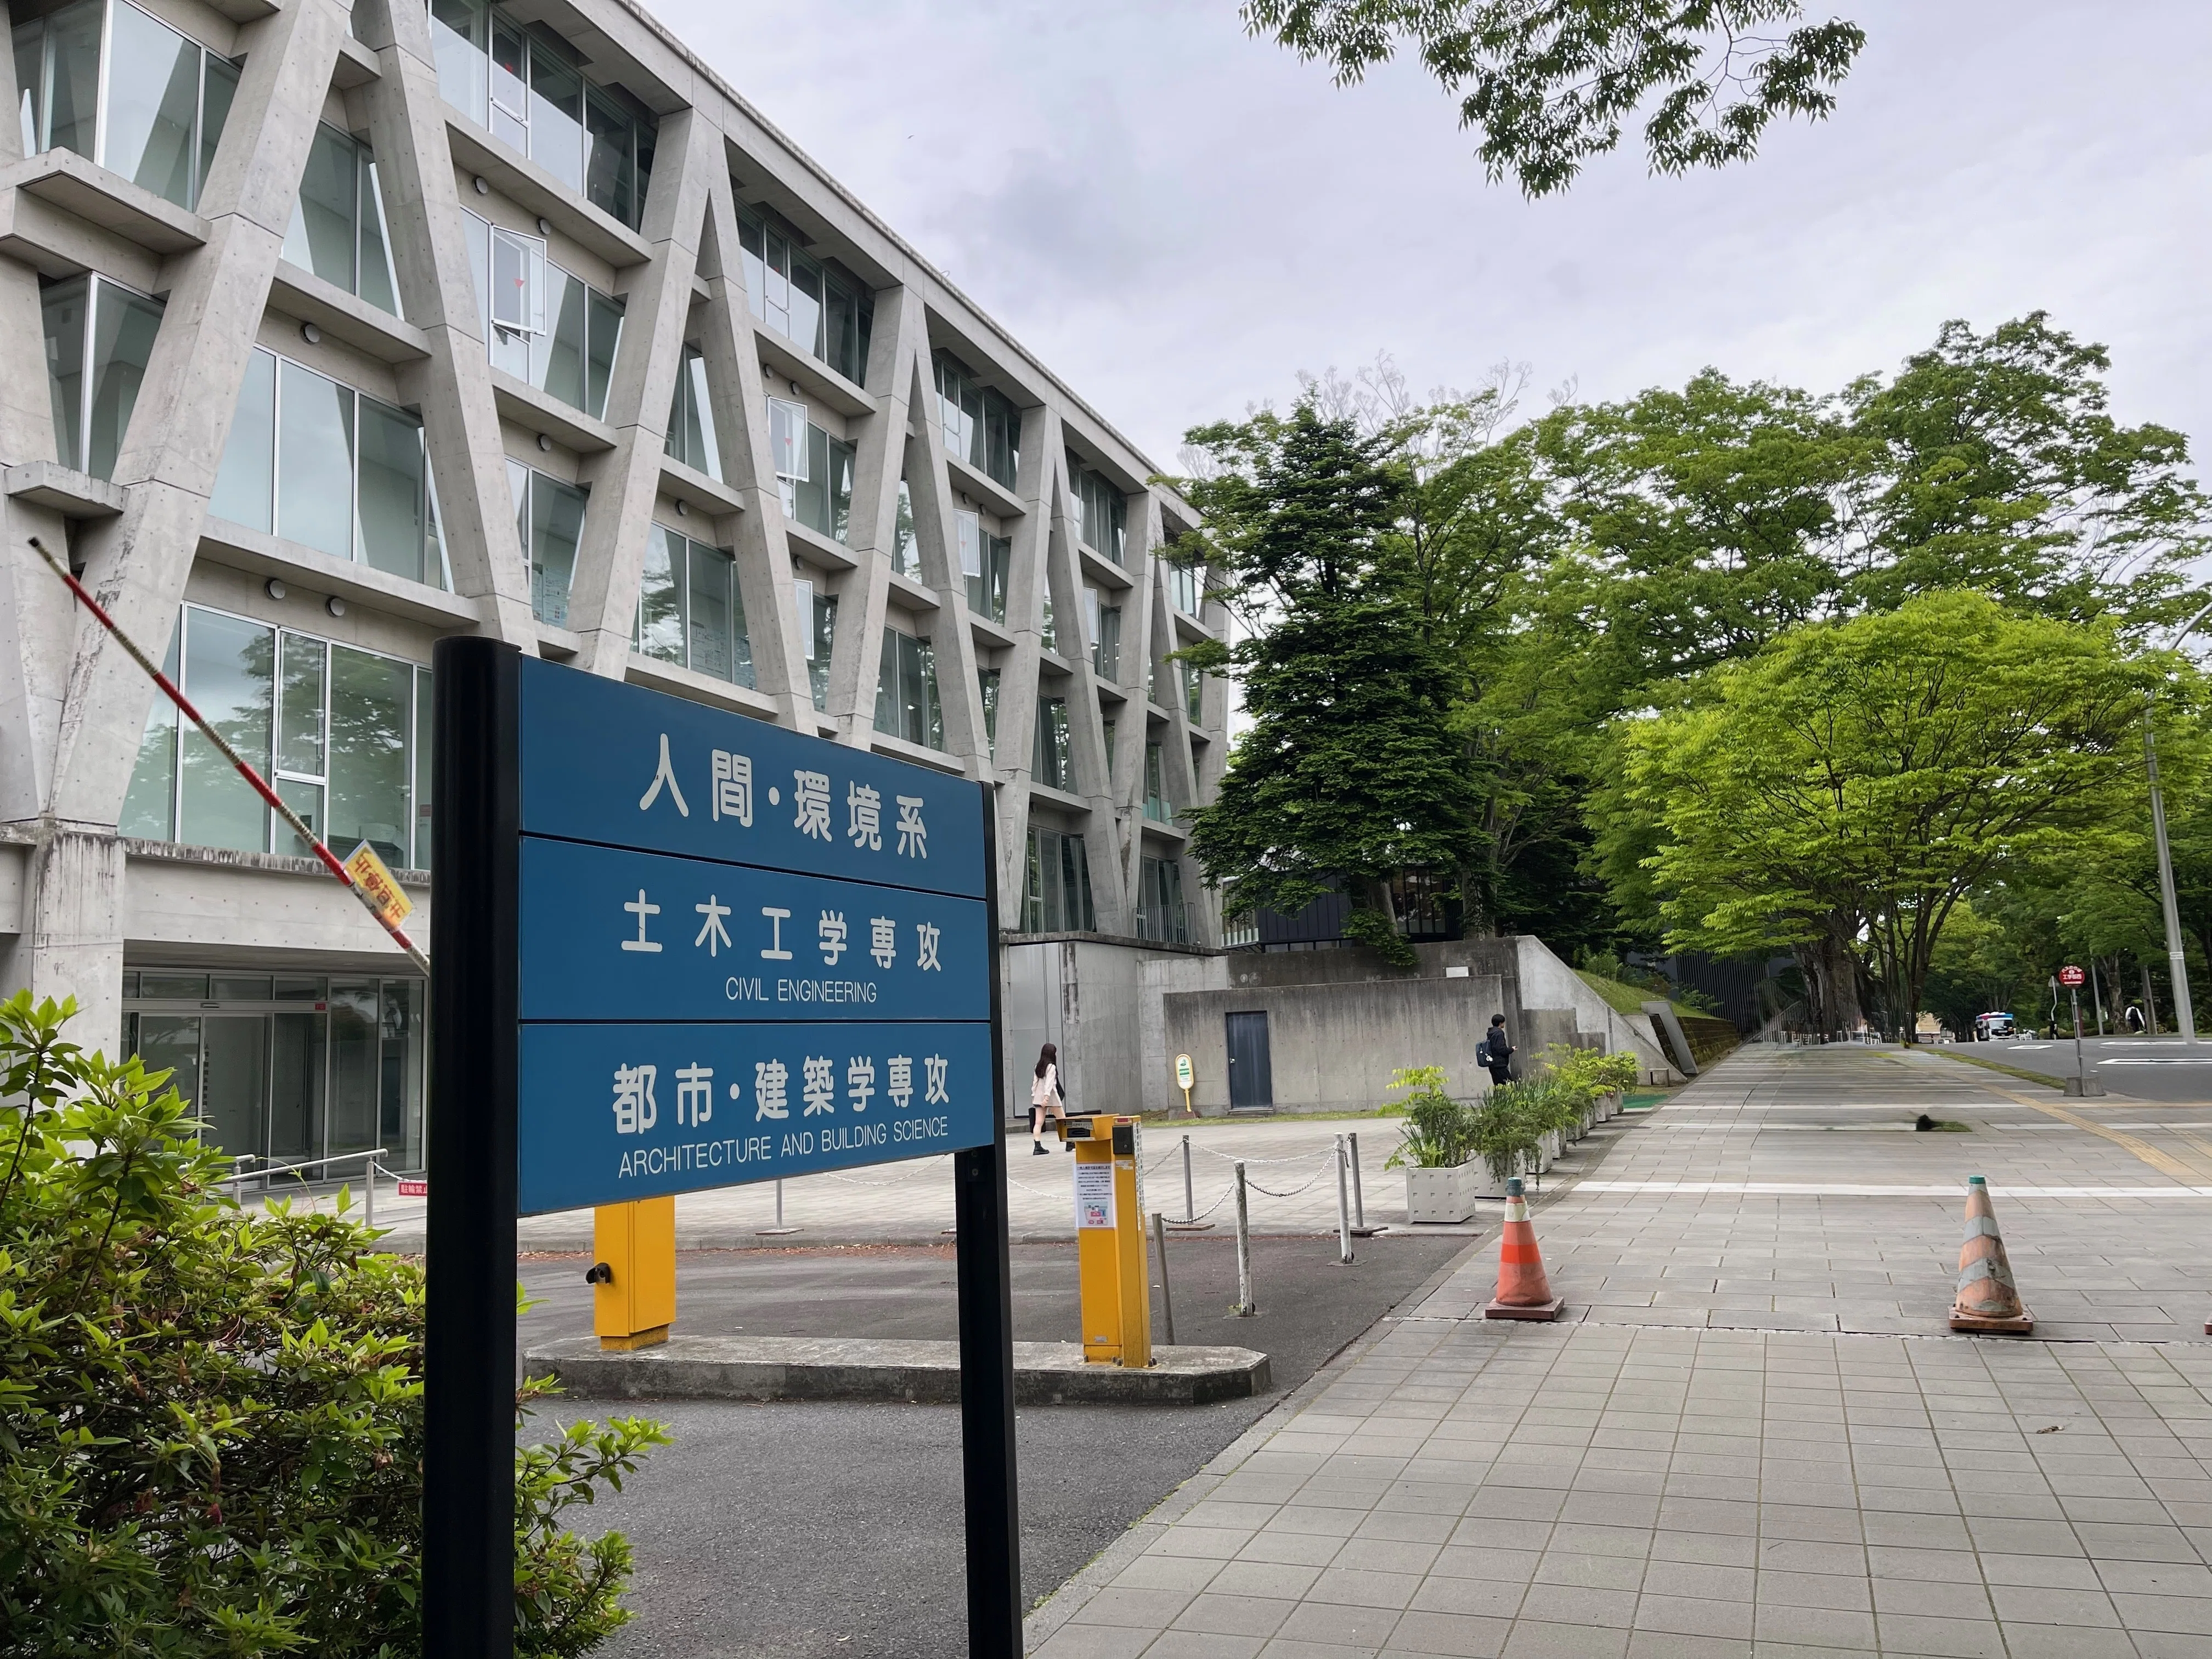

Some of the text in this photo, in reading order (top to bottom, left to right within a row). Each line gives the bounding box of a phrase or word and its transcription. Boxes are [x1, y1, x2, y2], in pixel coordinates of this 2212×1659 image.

[639, 733, 927, 859] 人間・環境系
[621, 889, 941, 972] 土木工学専攻
[726, 977, 877, 1003] CIVIL ENGINEERING
[612, 1053, 949, 1135] 都市・建築学専攻
[618, 1116, 948, 1178] ARCHITECTURE AND BUILDING SCIENCE
